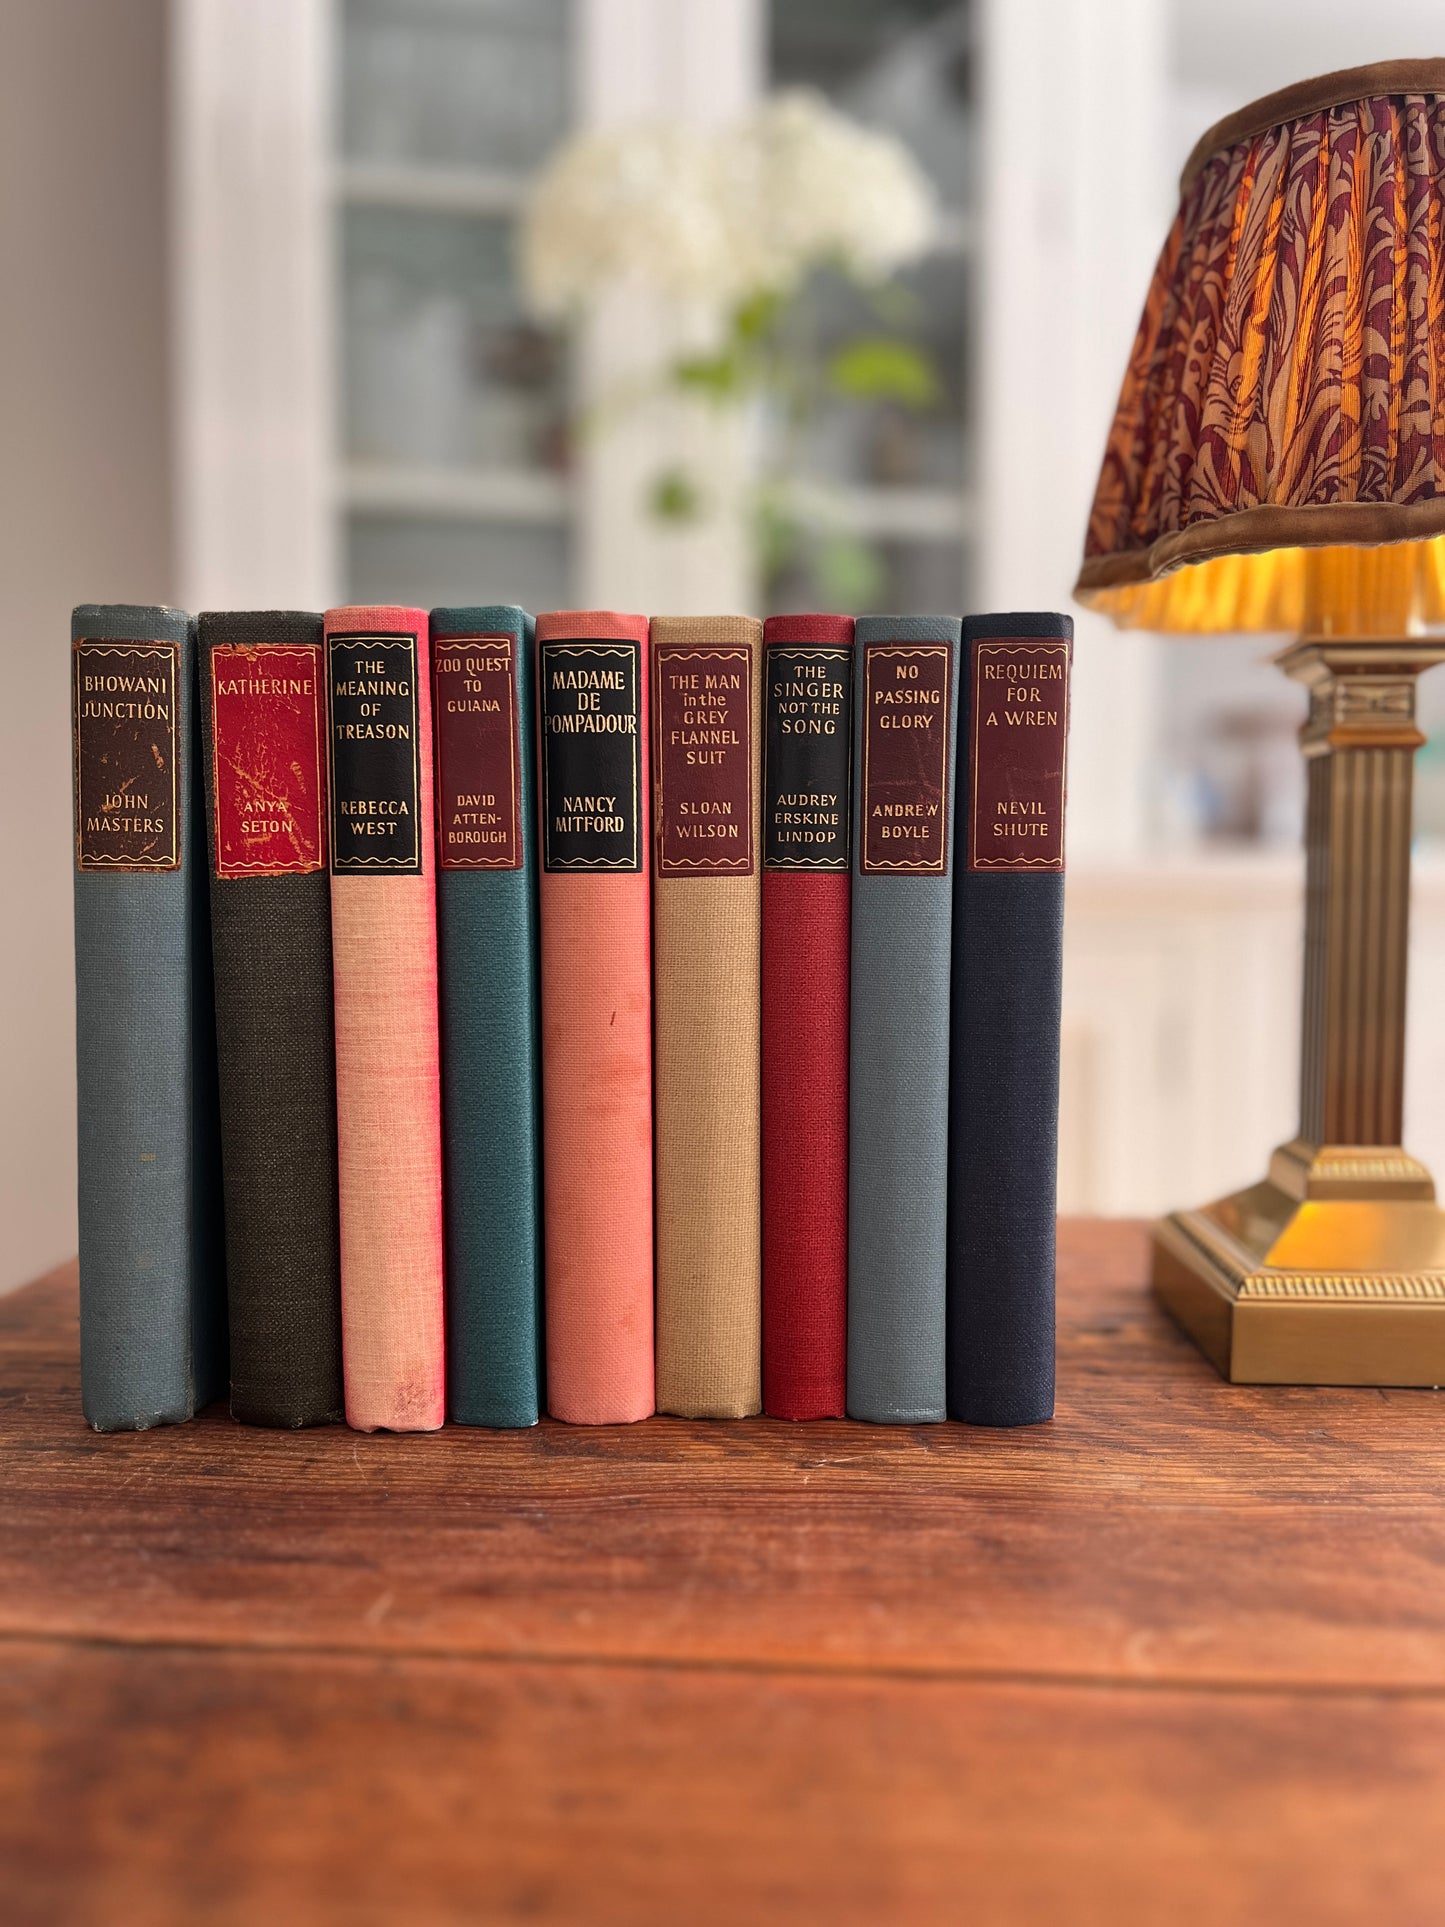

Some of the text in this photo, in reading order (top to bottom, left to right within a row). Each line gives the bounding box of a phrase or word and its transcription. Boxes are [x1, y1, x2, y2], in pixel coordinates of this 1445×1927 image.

[355, 661, 385, 674] THE
[436, 658, 511, 676] ZOO QUEST
[793, 666, 826, 678] THE
[896, 666, 918, 679] NO
[985, 664, 1062, 683] REQUIEM
[85, 676, 166, 693] BHOWANI
[218, 679, 312, 695] KATHERINE
[464, 680, 481, 692] TO
[553, 671, 625, 690] MADAME
[670, 675, 740, 689] THE MAN
[336, 681, 409, 696] MEANING
[774, 683, 843, 699] SINGER
[1007, 688, 1041, 702] FOR
[578, 693, 600, 711] DE
[684, 693, 726, 706] in the
[876, 690, 939, 704] PASSING
[82, 702, 169, 720] JUNCTION
[361, 704, 381, 717] OF
[448, 701, 500, 712] GUIANA
[779, 703, 839, 714] NOT THE
[545, 714, 636, 734] POMPADOUR
[684, 711, 728, 724] GREY
[880, 715, 933, 729] GLORY
[986, 711, 1057, 725] A WREN
[337, 725, 409, 739] TREASON
[782, 720, 835, 734] SONG
[672, 731, 739, 744] FLANNEL
[687, 751, 725, 764] SUIT
[104, 795, 148, 809] JOHN
[457, 795, 495, 806] DAVID
[563, 797, 616, 812] NANCY
[777, 794, 837, 806] AUDREY
[244, 802, 287, 812] ANYA
[341, 801, 409, 815] REBECCA
[680, 802, 731, 814] SLOAN
[873, 805, 938, 817] ANDREW
[997, 802, 1046, 814] NEVIL
[87, 818, 163, 833] MASTERS
[453, 814, 501, 824] ATTEN-
[556, 817, 624, 833] MITFORD
[775, 813, 838, 825] ERSKINE
[241, 820, 292, 833] SETON
[351, 822, 397, 835] WEST
[676, 825, 738, 837] WILSON
[882, 826, 929, 838] BOYLE
[994, 823, 1048, 836] SHUTE
[449, 832, 506, 843] BOROUGH
[778, 832, 836, 843] LINDOP
